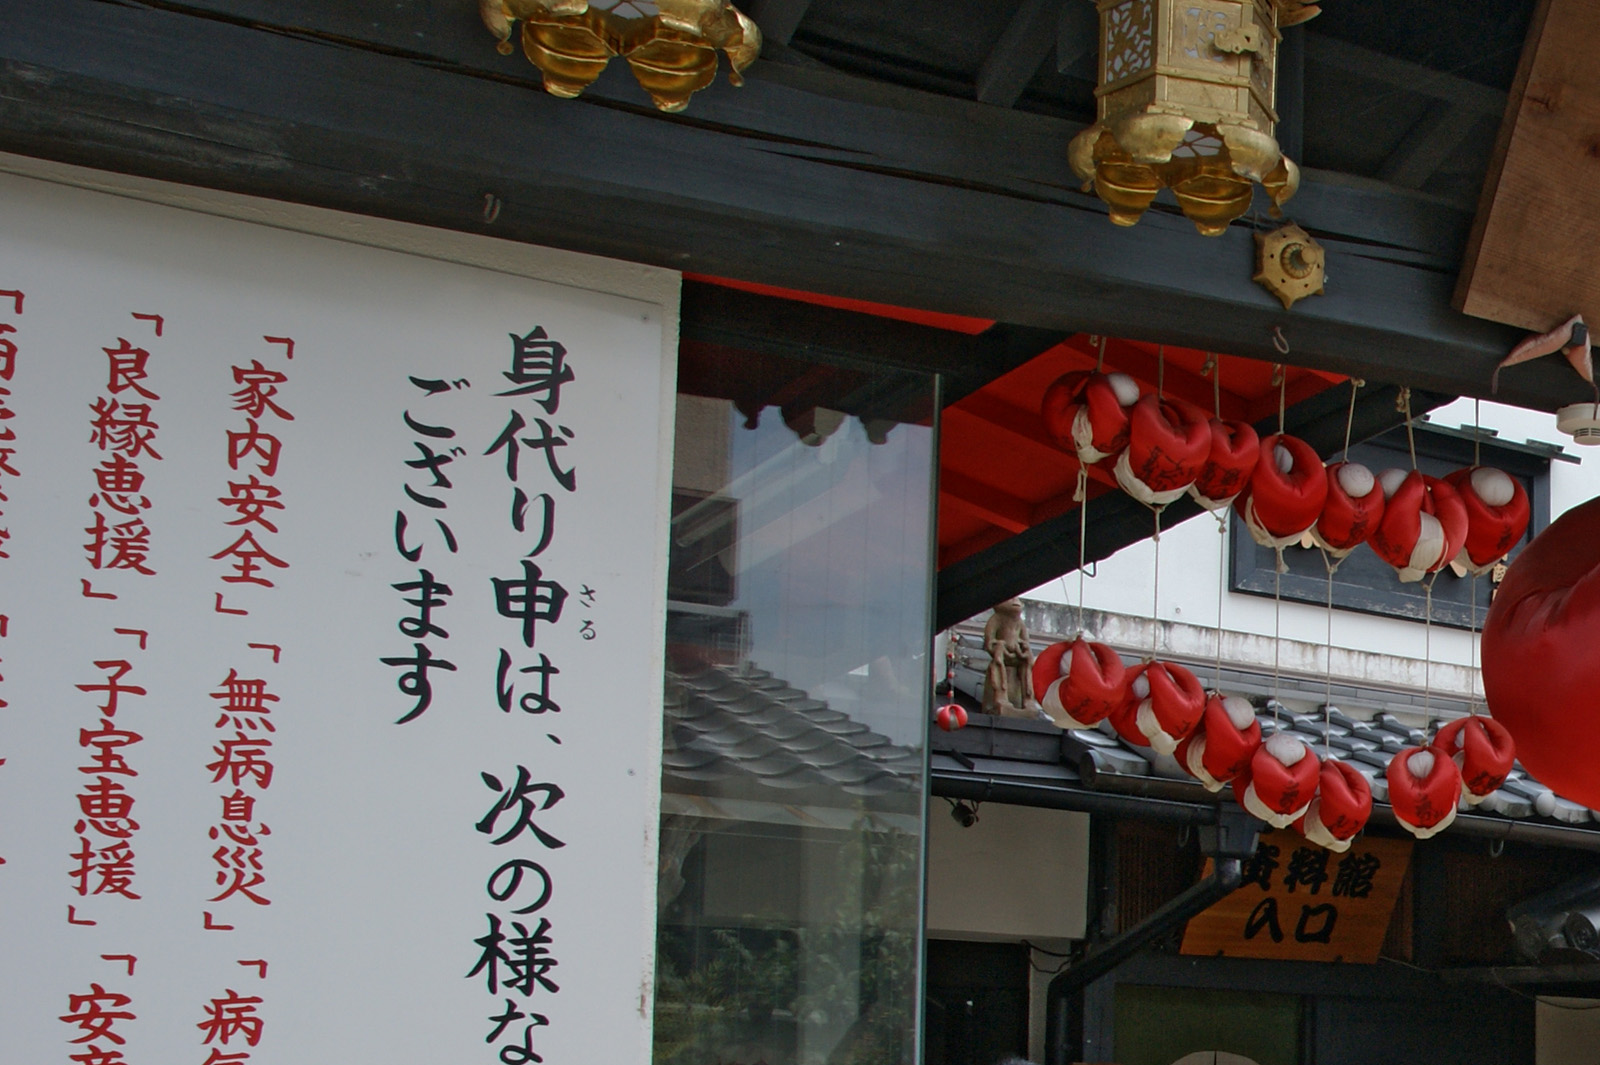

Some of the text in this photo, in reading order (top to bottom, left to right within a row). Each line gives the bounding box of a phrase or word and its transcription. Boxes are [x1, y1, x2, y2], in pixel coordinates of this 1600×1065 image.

[380, 375, 470, 725] ございます
[578, 583, 597, 641] さる
[1244, 897, 1338, 944] 入口
